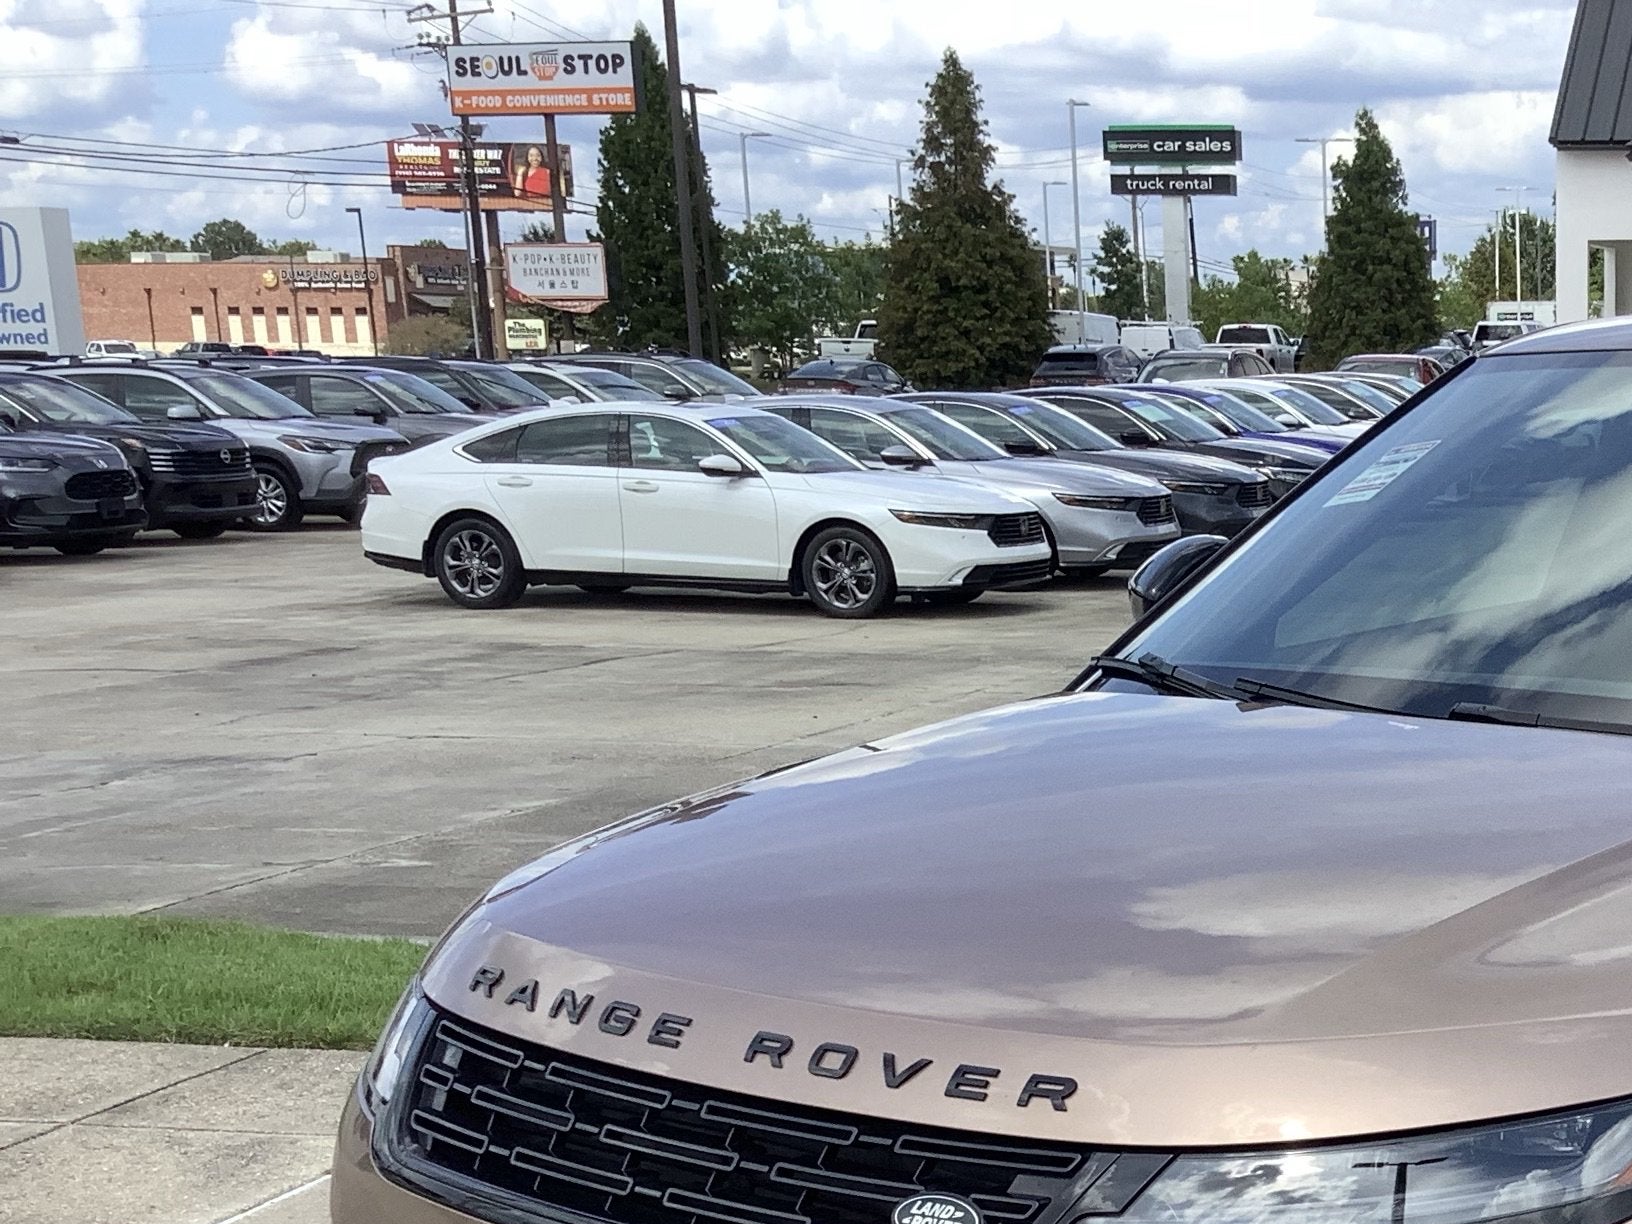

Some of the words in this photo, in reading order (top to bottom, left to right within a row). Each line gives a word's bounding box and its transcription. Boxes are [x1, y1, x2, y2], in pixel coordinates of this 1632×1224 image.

[454, 54, 529, 79] SEOUL
[562, 53, 625, 75] STOP
[454, 95, 502, 109] K-FOOD
[506, 93, 589, 108] CONVENIENCE
[592, 92, 632, 106] STORE
[1153, 139, 1181, 152] car
[1185, 136, 1232, 152] sales
[1126, 176, 1165, 190] truck
[1169, 176, 1213, 190] rental
[512, 253, 542, 265] K-POP
[548, 253, 599, 264] K-BEAUTY
[281, 269, 339, 281] DUMPLING
[343, 270, 350, 279] &
[523, 267, 560, 277] BANCHAN
[569, 267, 590, 277] MORE
[469, 966, 693, 1049] RANGE
[743, 1030, 1079, 1112] ROVER
[910, 1200, 956, 1219] LAND
